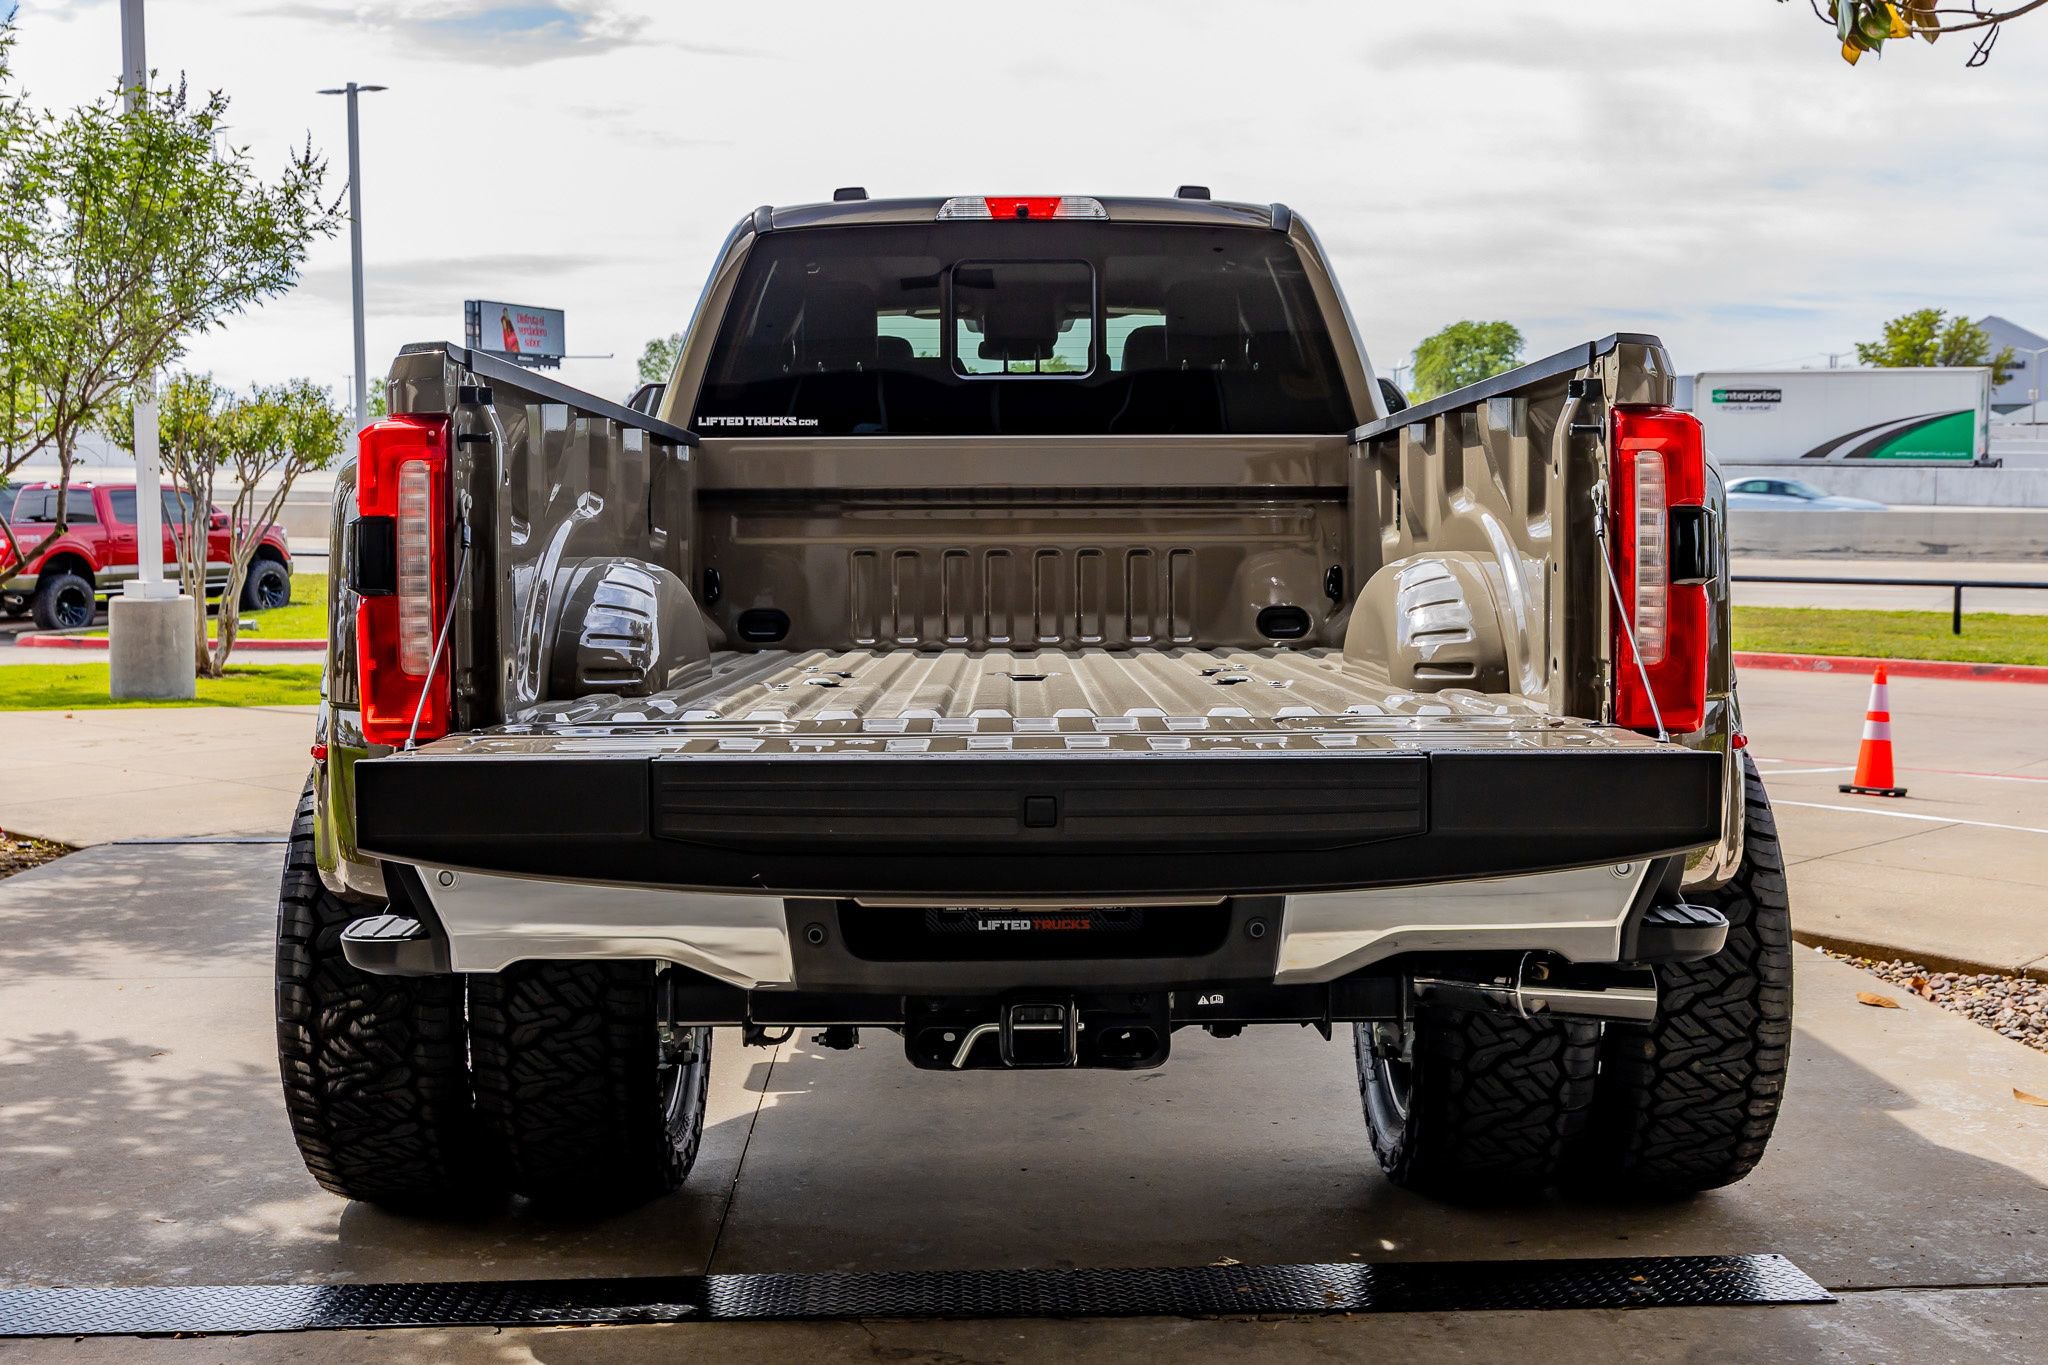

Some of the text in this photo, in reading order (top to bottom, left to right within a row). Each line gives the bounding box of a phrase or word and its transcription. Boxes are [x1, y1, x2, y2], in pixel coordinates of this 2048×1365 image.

[1713, 391, 1781, 402] enterprise
[698, 416, 744, 426] LIFTED
[978, 919, 1090, 931] LIFTED TRUCKS
